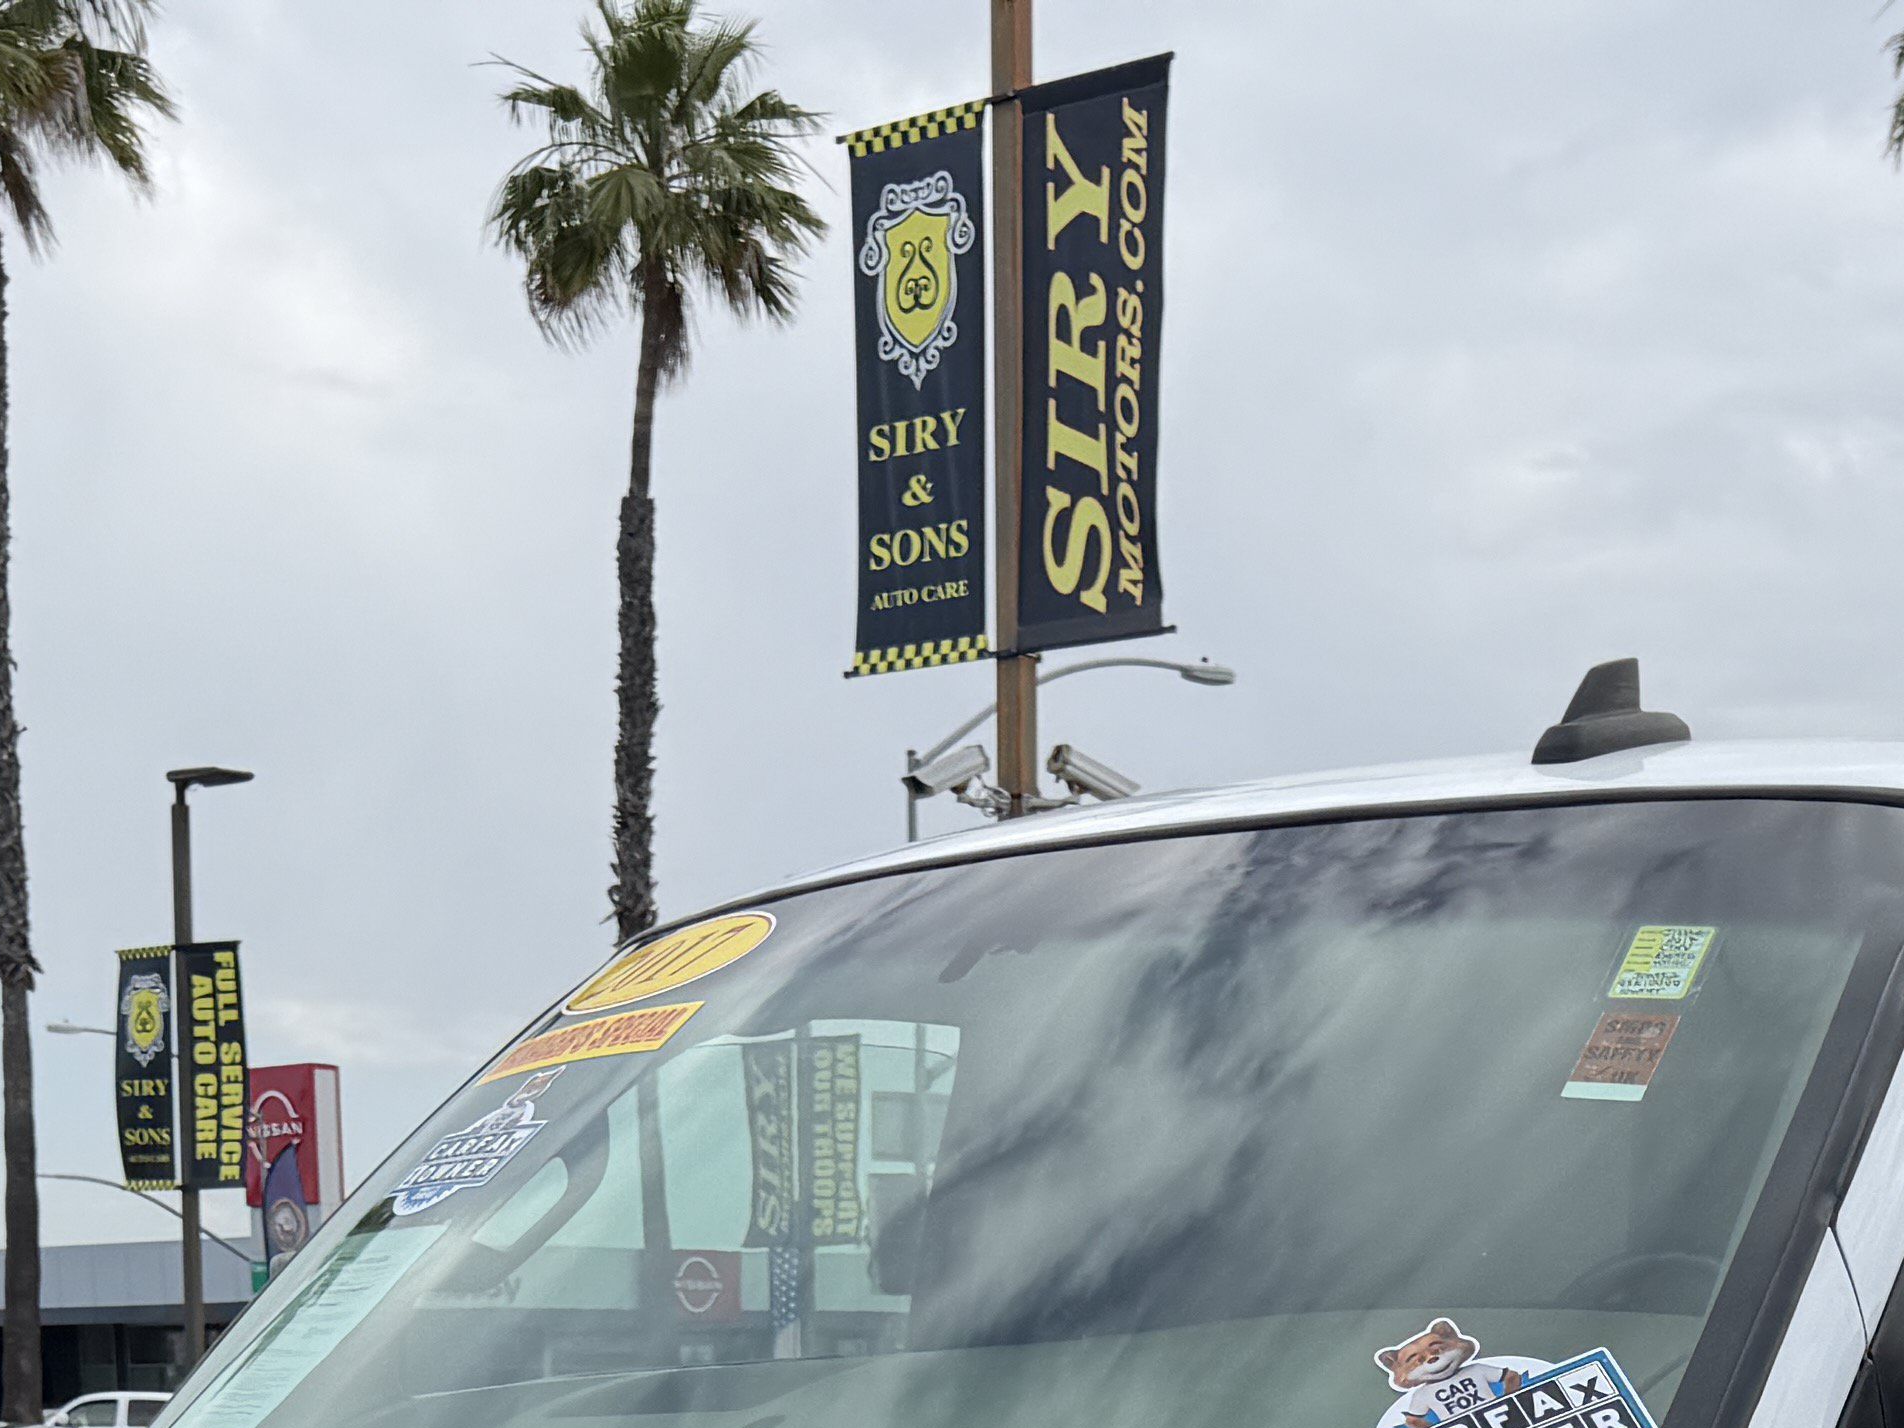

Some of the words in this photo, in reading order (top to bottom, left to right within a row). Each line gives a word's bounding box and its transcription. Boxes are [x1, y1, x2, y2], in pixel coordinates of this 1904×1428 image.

[1043, 112, 1112, 614] SIRY
[1116, 98, 1150, 605] MOTORS.COM
[868, 408, 966, 461] SIRY
[901, 474, 934, 507] &
[869, 519, 969, 571] SONS
[870, 588, 919, 611] AUTO
[921, 579, 970, 603] CARE
[582, 922, 755, 999] 2017
[213, 951, 239, 1027] FULL
[191, 974, 217, 1065] AUTO
[121, 1079, 169, 1097] SIRY
[138, 1105, 154, 1119] &
[219, 1041, 244, 1181] SERVICE
[124, 1127, 171, 1146] SONS
[195, 1073, 219, 1160] CARE
[430, 1132, 522, 1159] CARFAX
[1434, 1376, 1476, 1402] CAR
[1444, 1388, 1485, 1416] FOX
